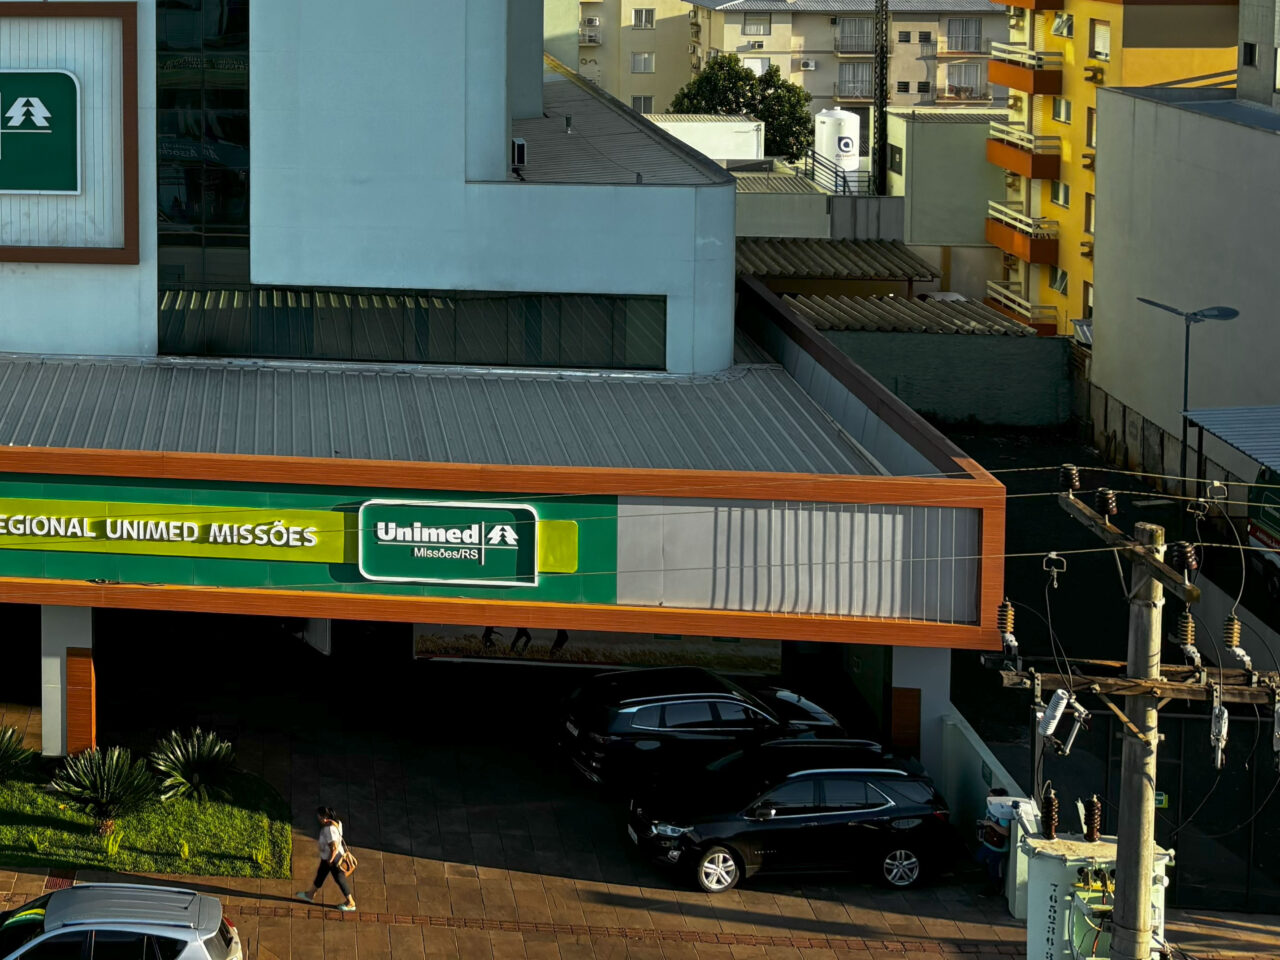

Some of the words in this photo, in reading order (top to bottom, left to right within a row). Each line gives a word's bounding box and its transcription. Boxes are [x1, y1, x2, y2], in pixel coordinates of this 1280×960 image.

[106, 518, 198, 542] UNIMED
[209, 519, 318, 547] MISSÕES
[376, 522, 480, 544] Unimed
[414, 546, 479, 560] Missões/RS
